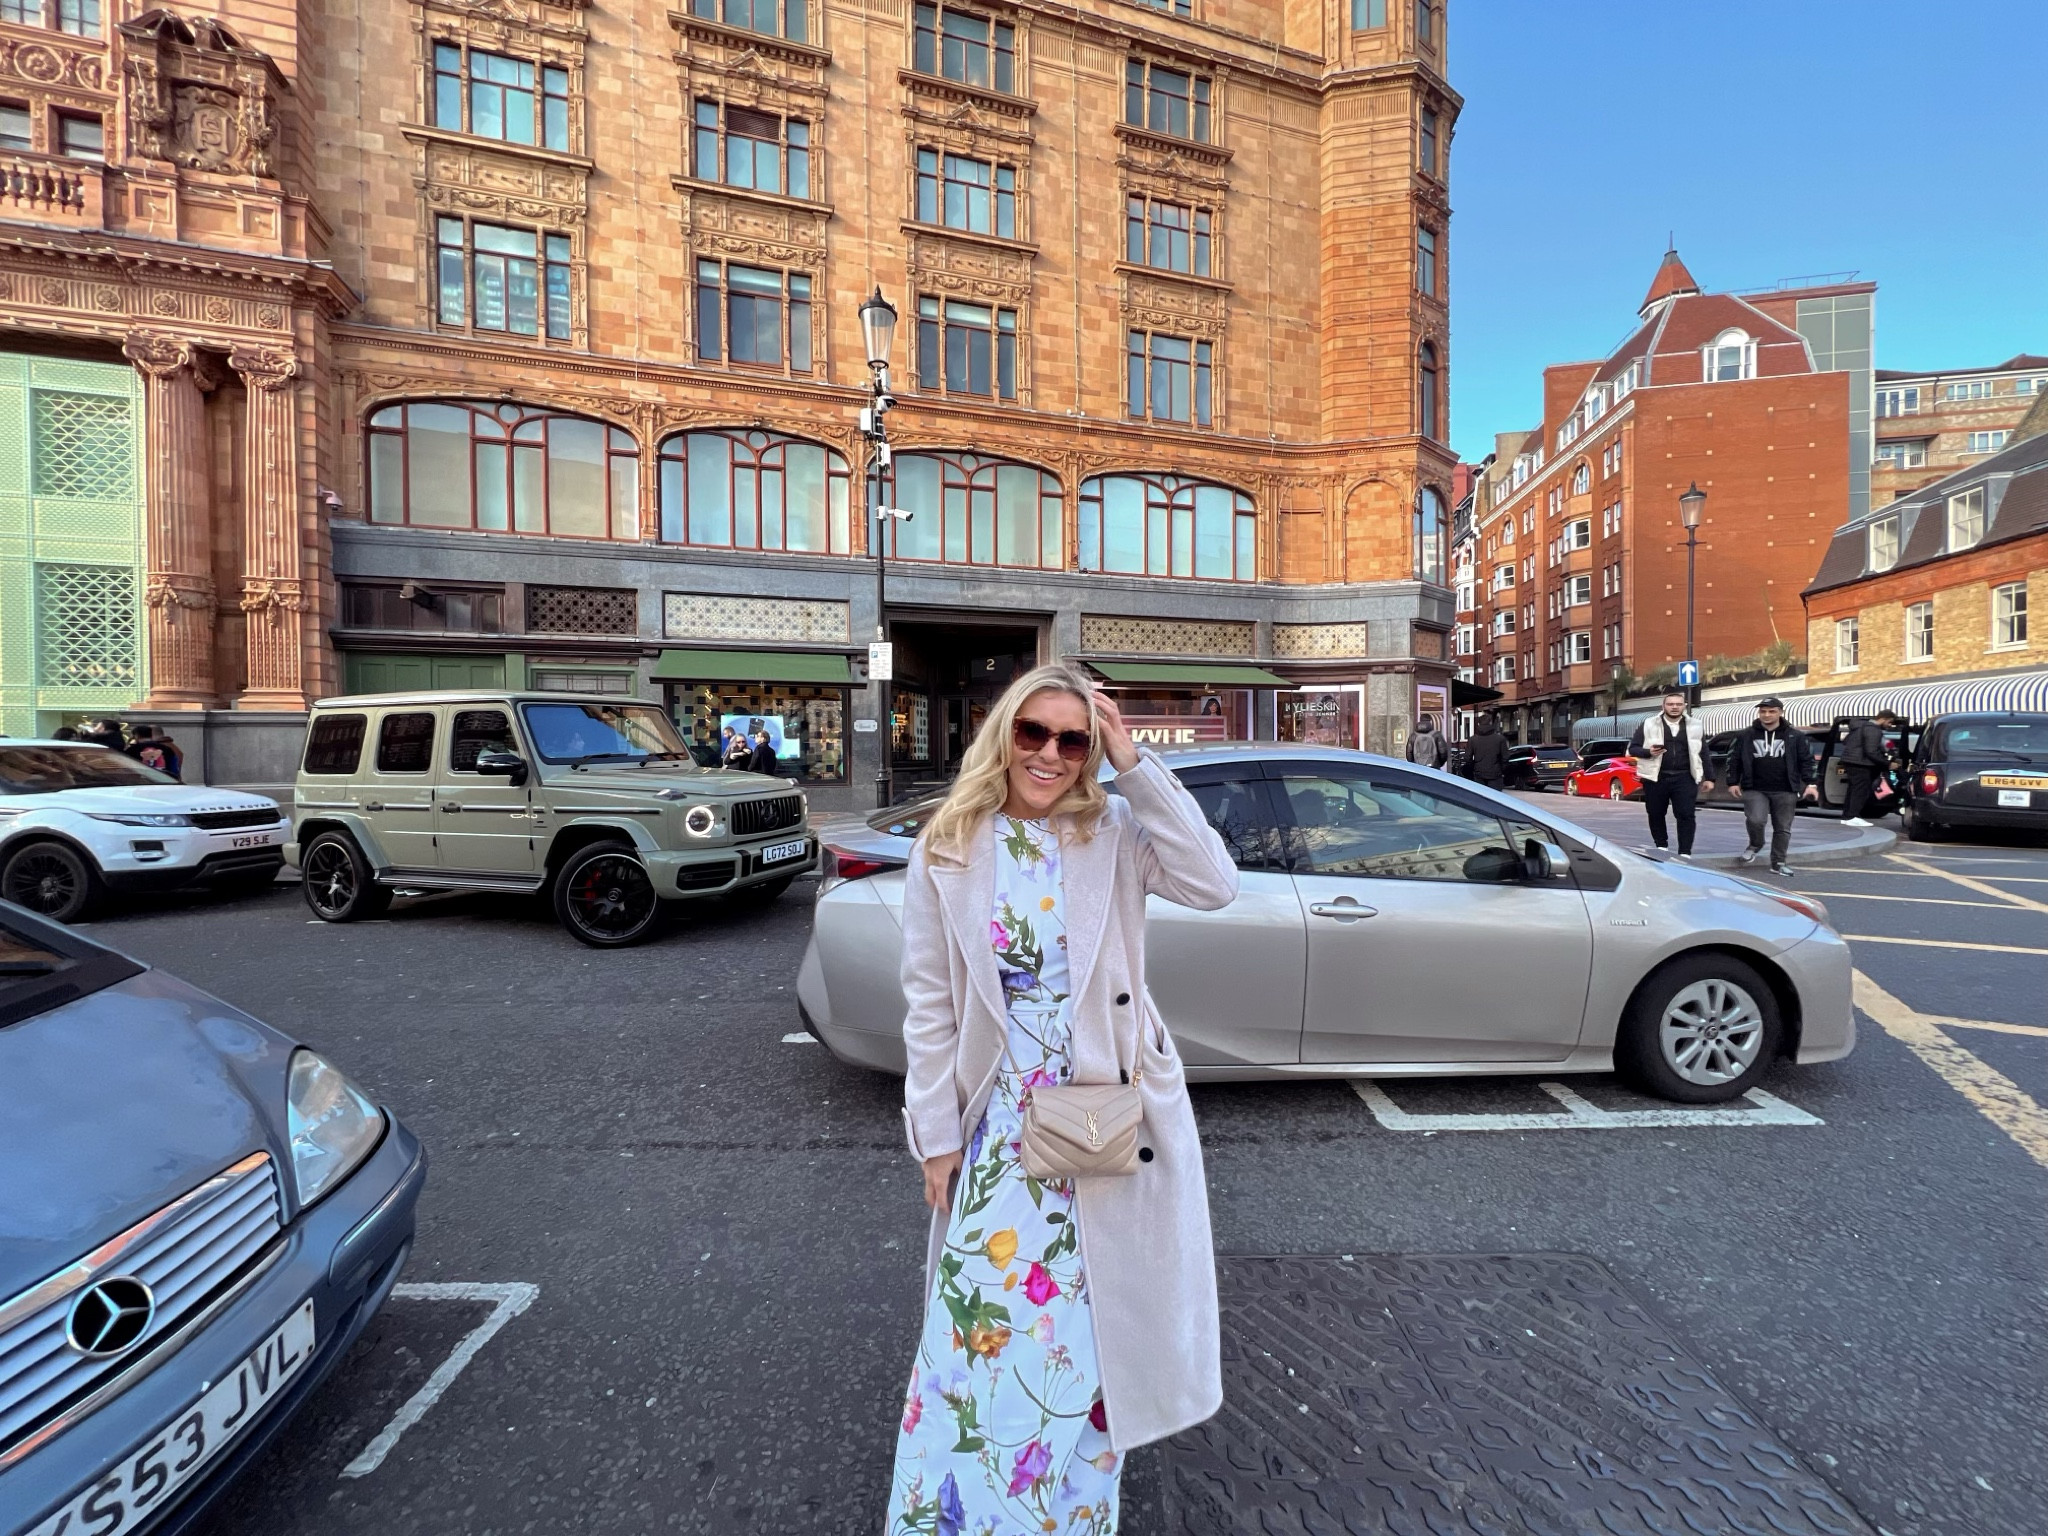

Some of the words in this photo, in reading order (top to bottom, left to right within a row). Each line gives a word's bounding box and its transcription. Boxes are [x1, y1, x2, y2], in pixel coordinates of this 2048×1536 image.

[986, 658, 995, 670] 2
[232, 837, 251, 847] V29
[253, 835, 270, 845] SJE
[766, 846, 786, 860] LG72
[1086, 1110, 1103, 1146] YSL
[223, 1333, 299, 1429] JVL
